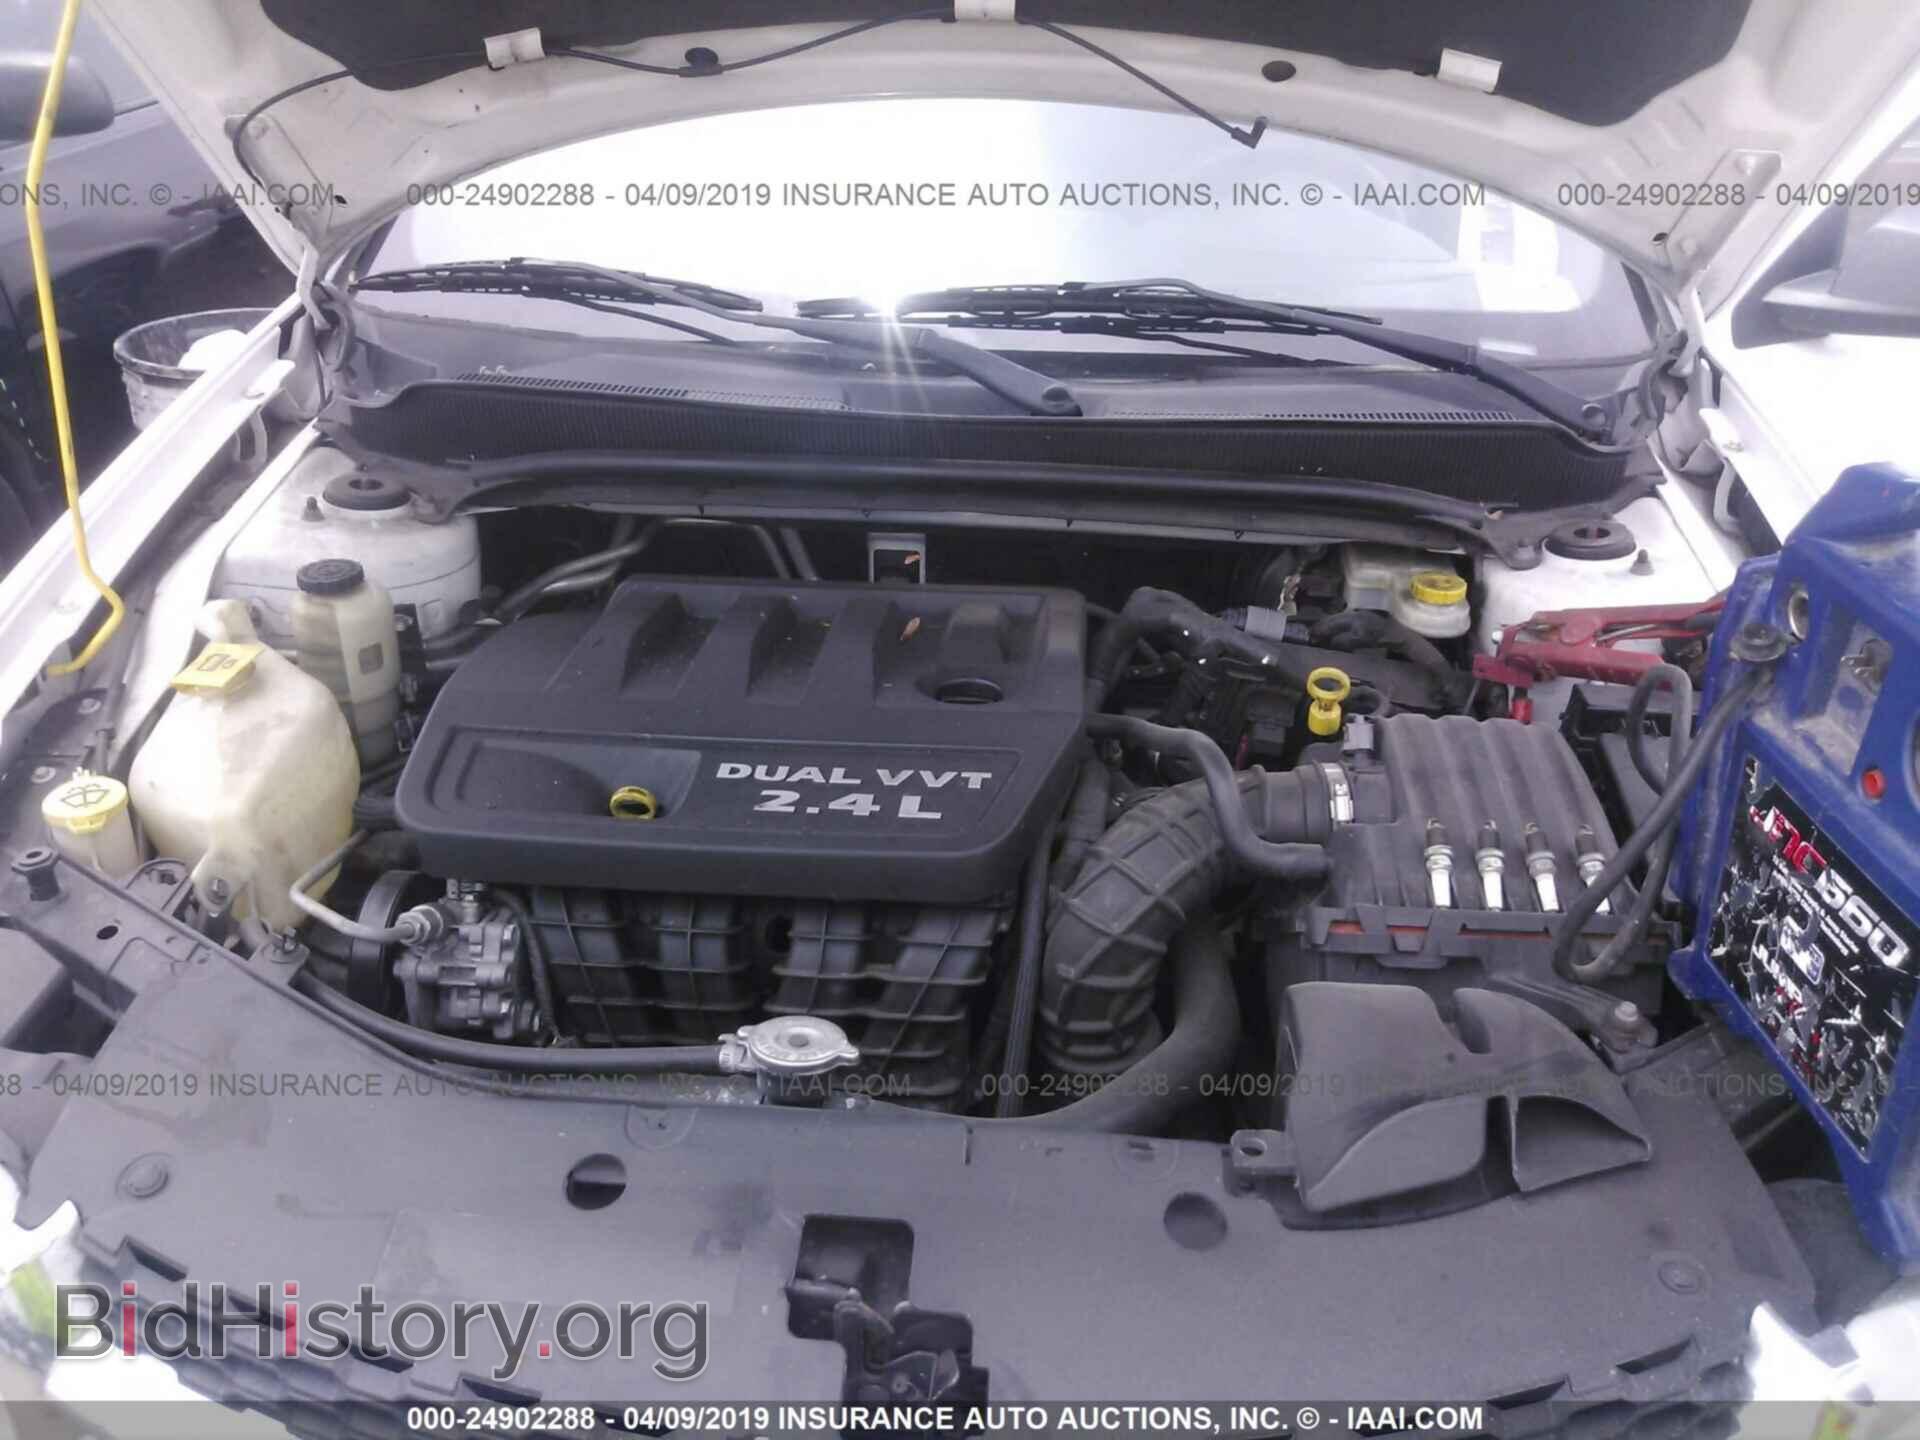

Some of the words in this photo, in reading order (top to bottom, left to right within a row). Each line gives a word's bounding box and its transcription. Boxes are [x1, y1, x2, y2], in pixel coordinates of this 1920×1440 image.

[716, 762, 862, 785] DUAL
[876, 768, 992, 789] VVT
[753, 789, 881, 817] 2.4
[898, 795, 942, 819] L
